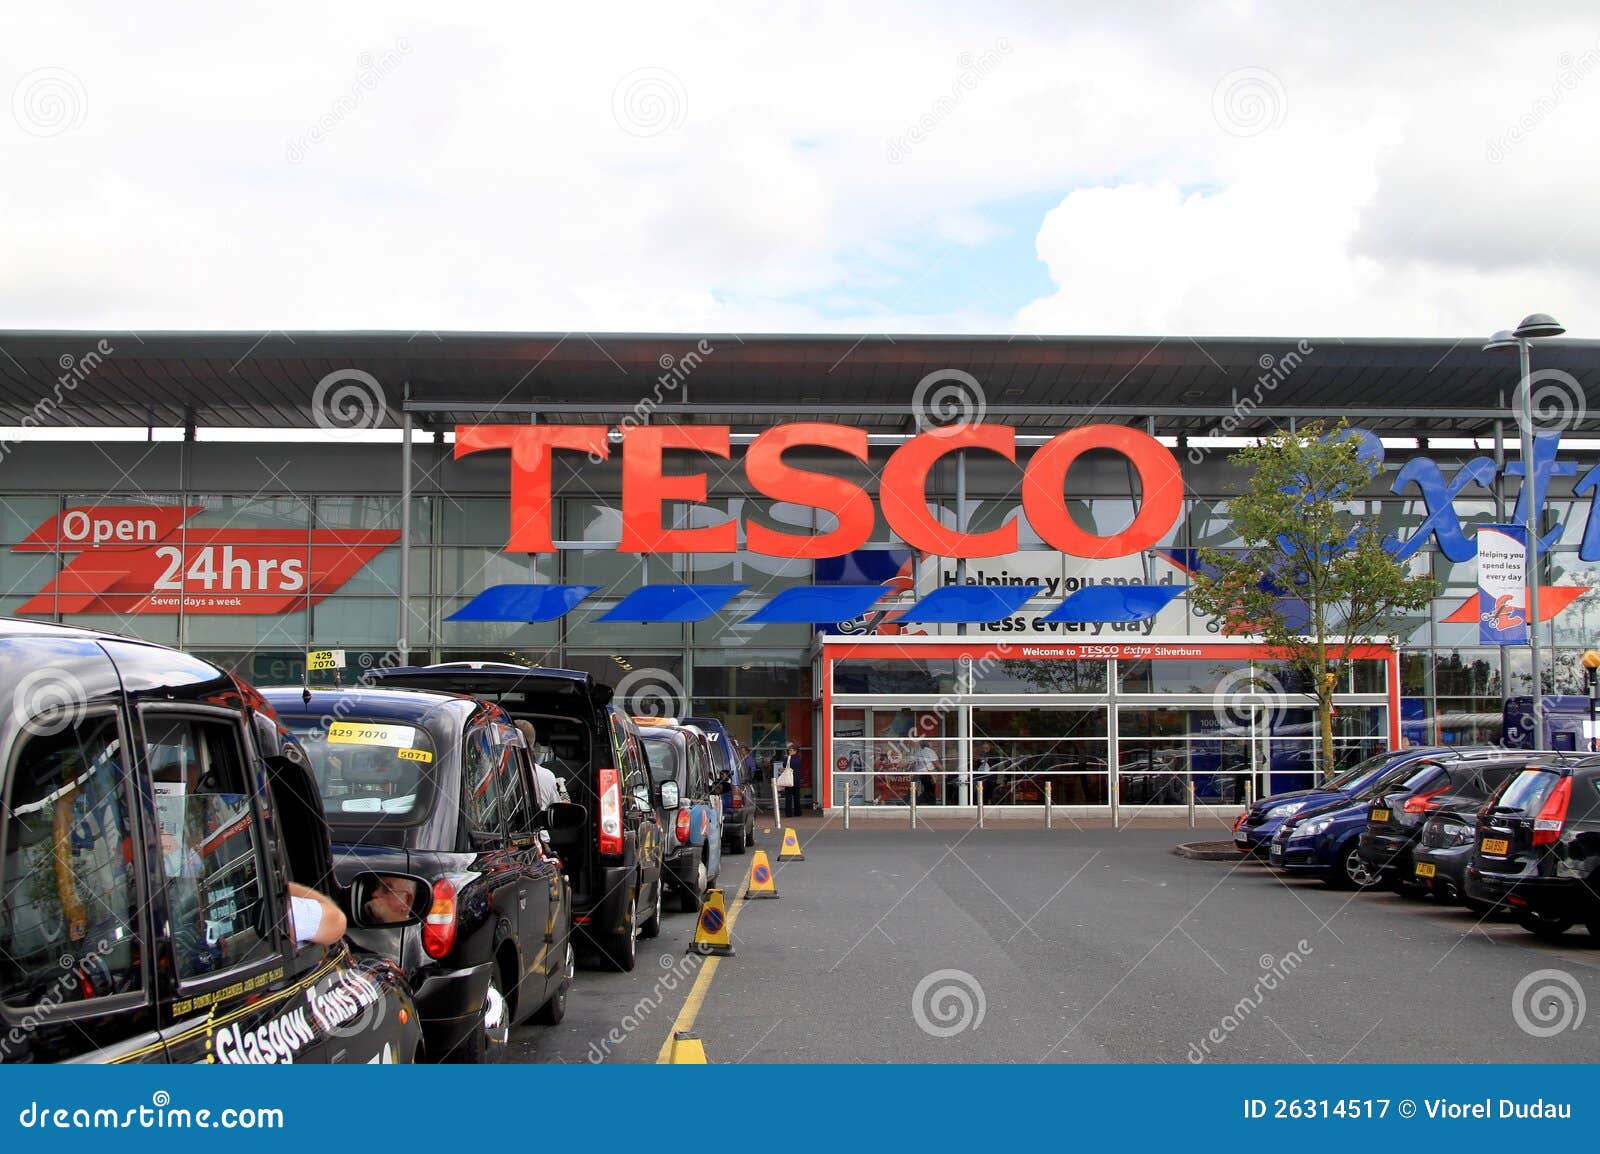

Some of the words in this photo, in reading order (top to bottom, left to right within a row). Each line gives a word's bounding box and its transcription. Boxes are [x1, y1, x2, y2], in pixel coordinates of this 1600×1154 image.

[454, 422, 1184, 560] TESCO
[62, 510, 157, 547] Open
[1480, 550, 1508, 560] Helping
[1510, 552, 1524, 560] you
[153, 545, 304, 591] 24hrs
[1482, 562, 1505, 570] spend
[1100, 571, 1173, 587] sped
[1507, 573, 1522, 582] day
[150, 596, 180, 606] Seven
[183, 596, 206, 609] days
[216, 596, 241, 606] week
[979, 616, 1026, 632] less
[315, 651, 333, 660] 429
[1022, 647, 1063, 656] Welcome
[1066, 647, 1076, 656] to
[1079, 645, 1120, 656] TESCO
[1154, 647, 1202, 656] Silverburn
[313, 660, 336, 669] 7070
[329, 728, 352, 738] 429
[357, 730, 388, 740] 7070
[706, 732, 720, 742] XI
[400, 750, 427, 761] 5071
[216, 1006, 315, 1064] Glasgow
